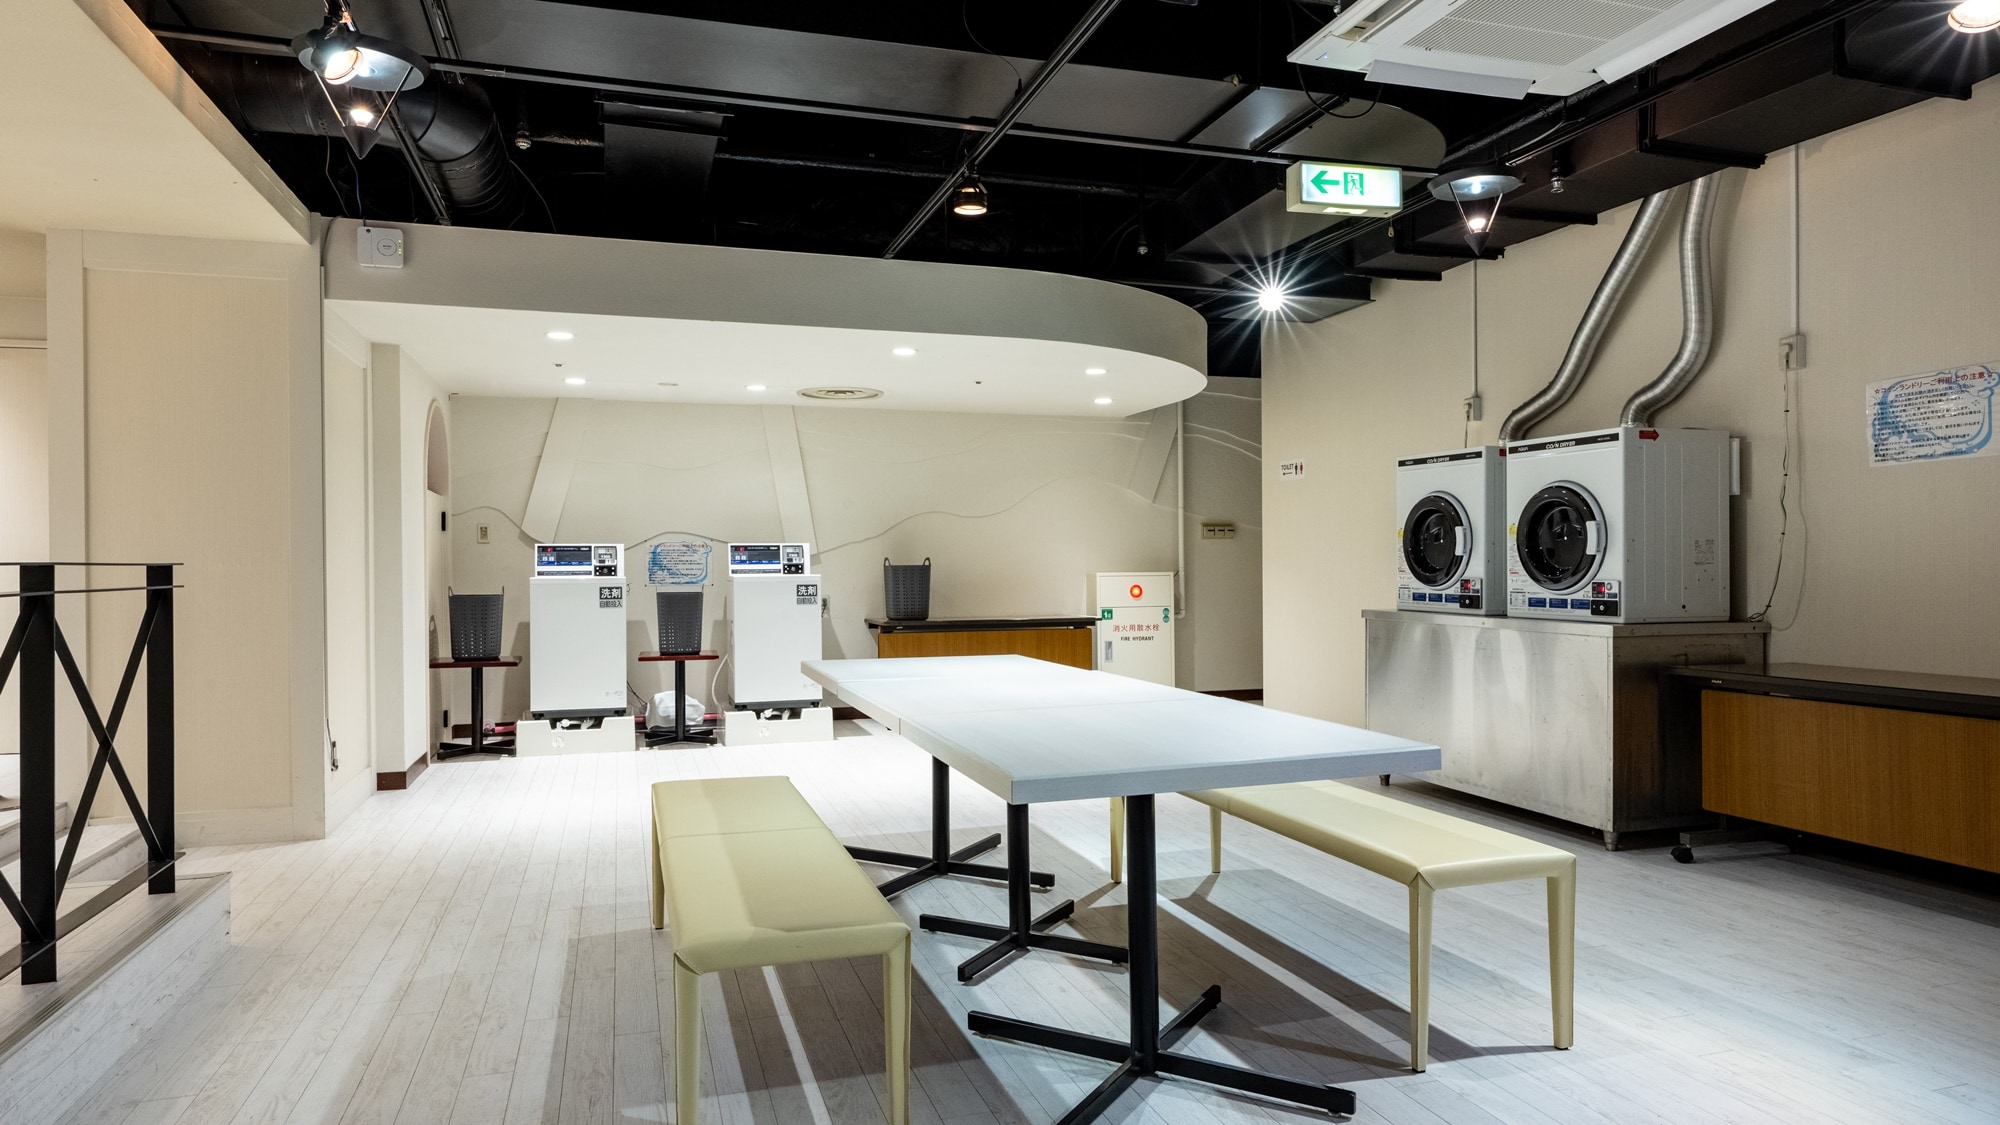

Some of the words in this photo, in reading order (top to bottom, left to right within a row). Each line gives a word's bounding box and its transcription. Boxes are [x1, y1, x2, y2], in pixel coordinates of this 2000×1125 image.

[1281, 463, 1294, 471] TOILET
[600, 588, 622, 599] 洗剤
[798, 585, 816, 596] 洗剤
[599, 600, 622, 608] 自動投入
[796, 597, 818, 605] 自動投入
[1112, 623, 1160, 633] 消火用散水栓
